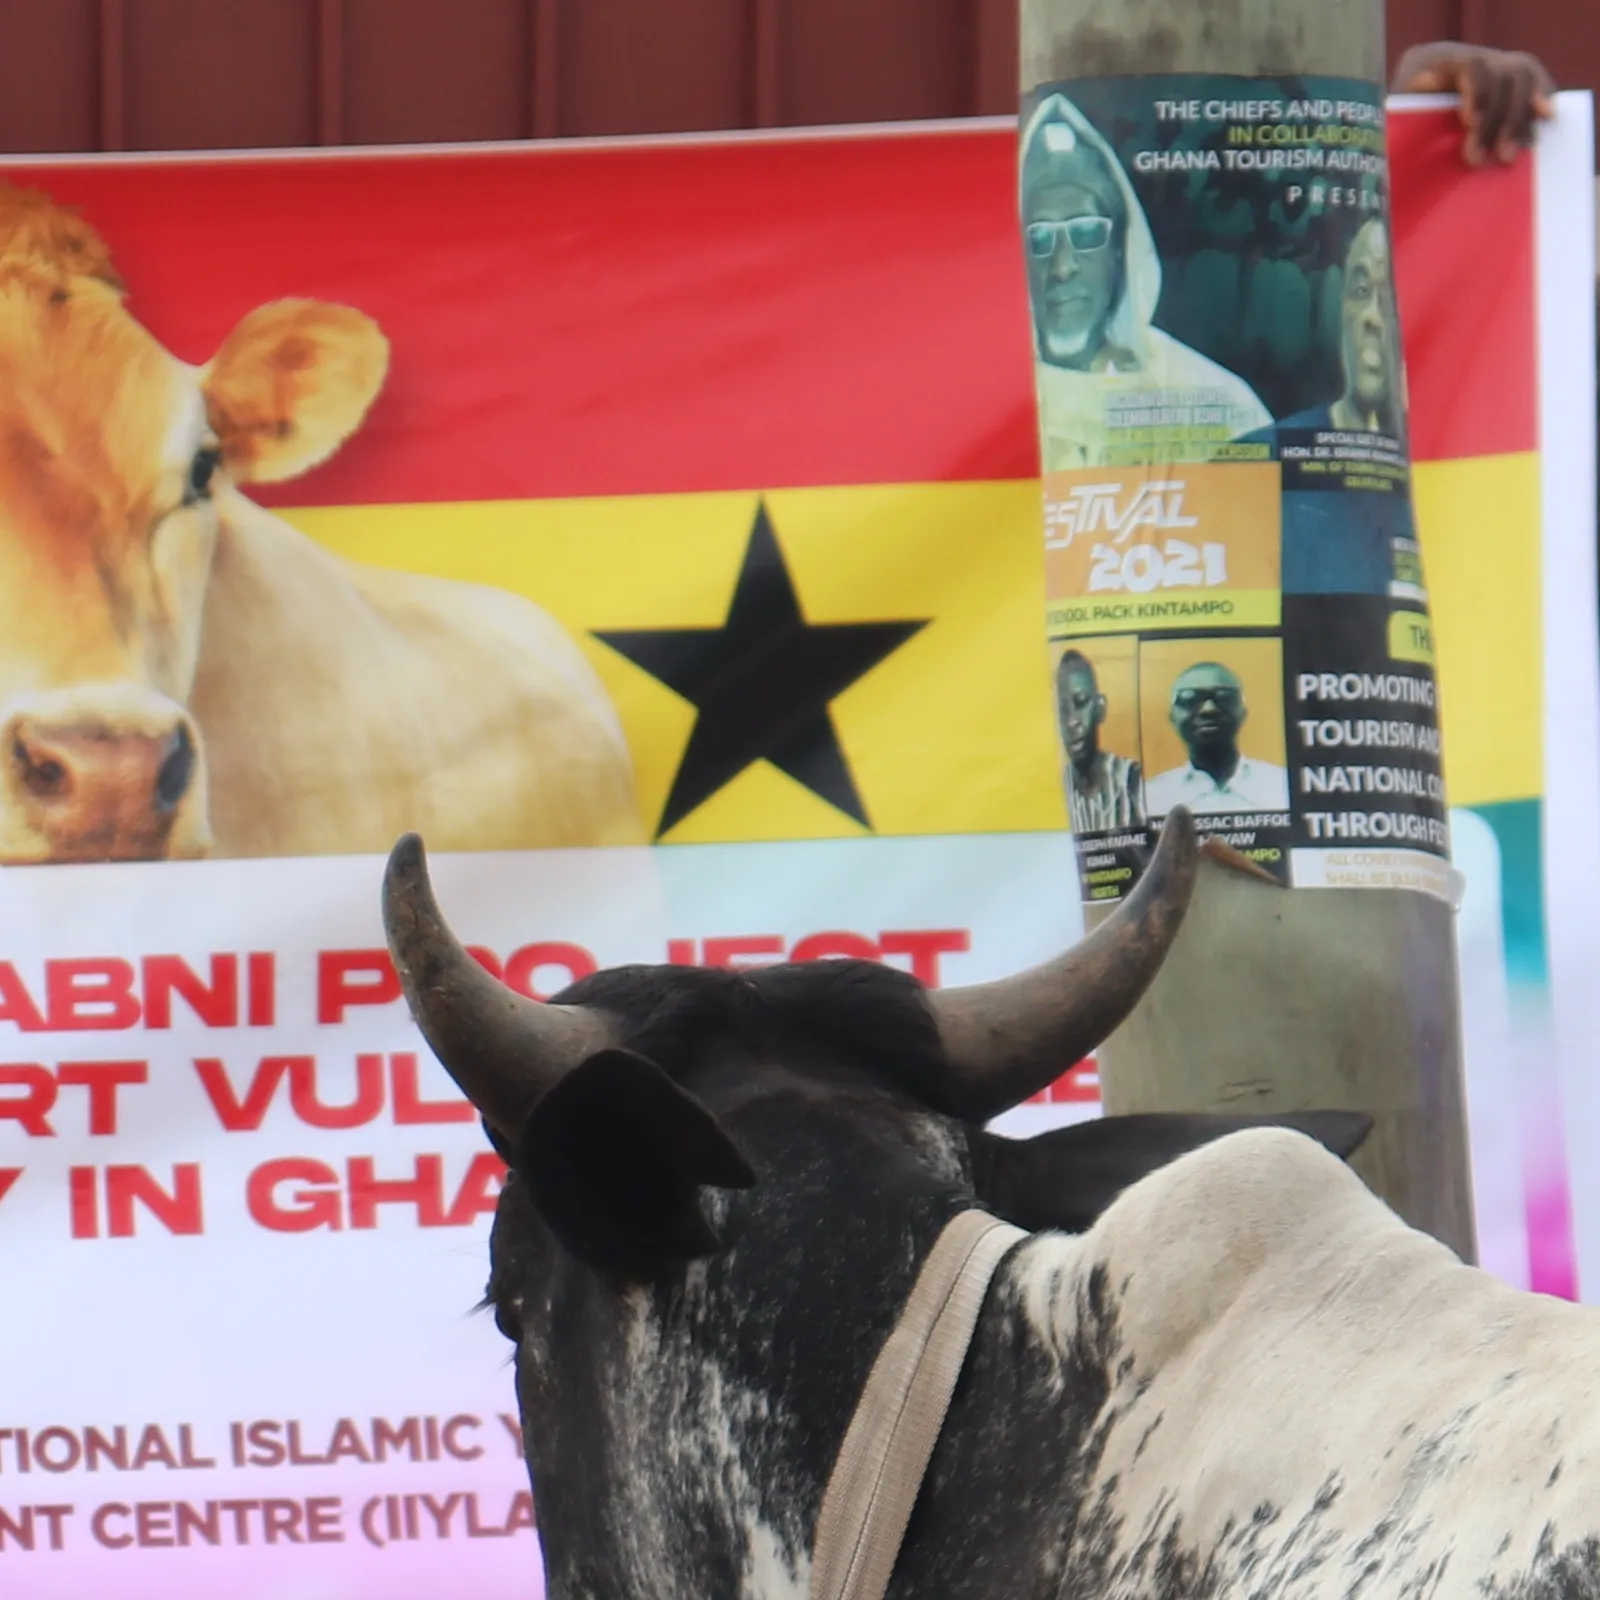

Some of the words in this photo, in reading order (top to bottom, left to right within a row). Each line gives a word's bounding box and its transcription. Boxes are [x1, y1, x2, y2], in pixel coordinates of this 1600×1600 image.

[1155, 99, 1201, 119] THE
[1204, 99, 1282, 120] CHIEFS
[1287, 99, 1333, 119] AND
[1229, 125, 1252, 144] IN
[1134, 150, 1221, 171] GHANA
[1223, 149, 1323, 170] TOURISM
[1327, 151, 1386, 175] AUTHO
[1043, 479, 1199, 551] ESTIVAL
[1089, 537, 1228, 594] 2021
[1137, 599, 1234, 618] KINTAMPO
[1296, 673, 1435, 707] PROMOTING
[1297, 718, 1415, 749] TOURISM
[1302, 765, 1425, 797] NATIONAL
[1195, 816, 1233, 831] SSAC
[1305, 811, 1428, 843] THROUGH
[68, 1162, 204, 1240] IN
[245, 1152, 513, 1234] GHA
[230, 1413, 485, 1469] ISLAMIC
[91, 1495, 348, 1551] CENTRE
